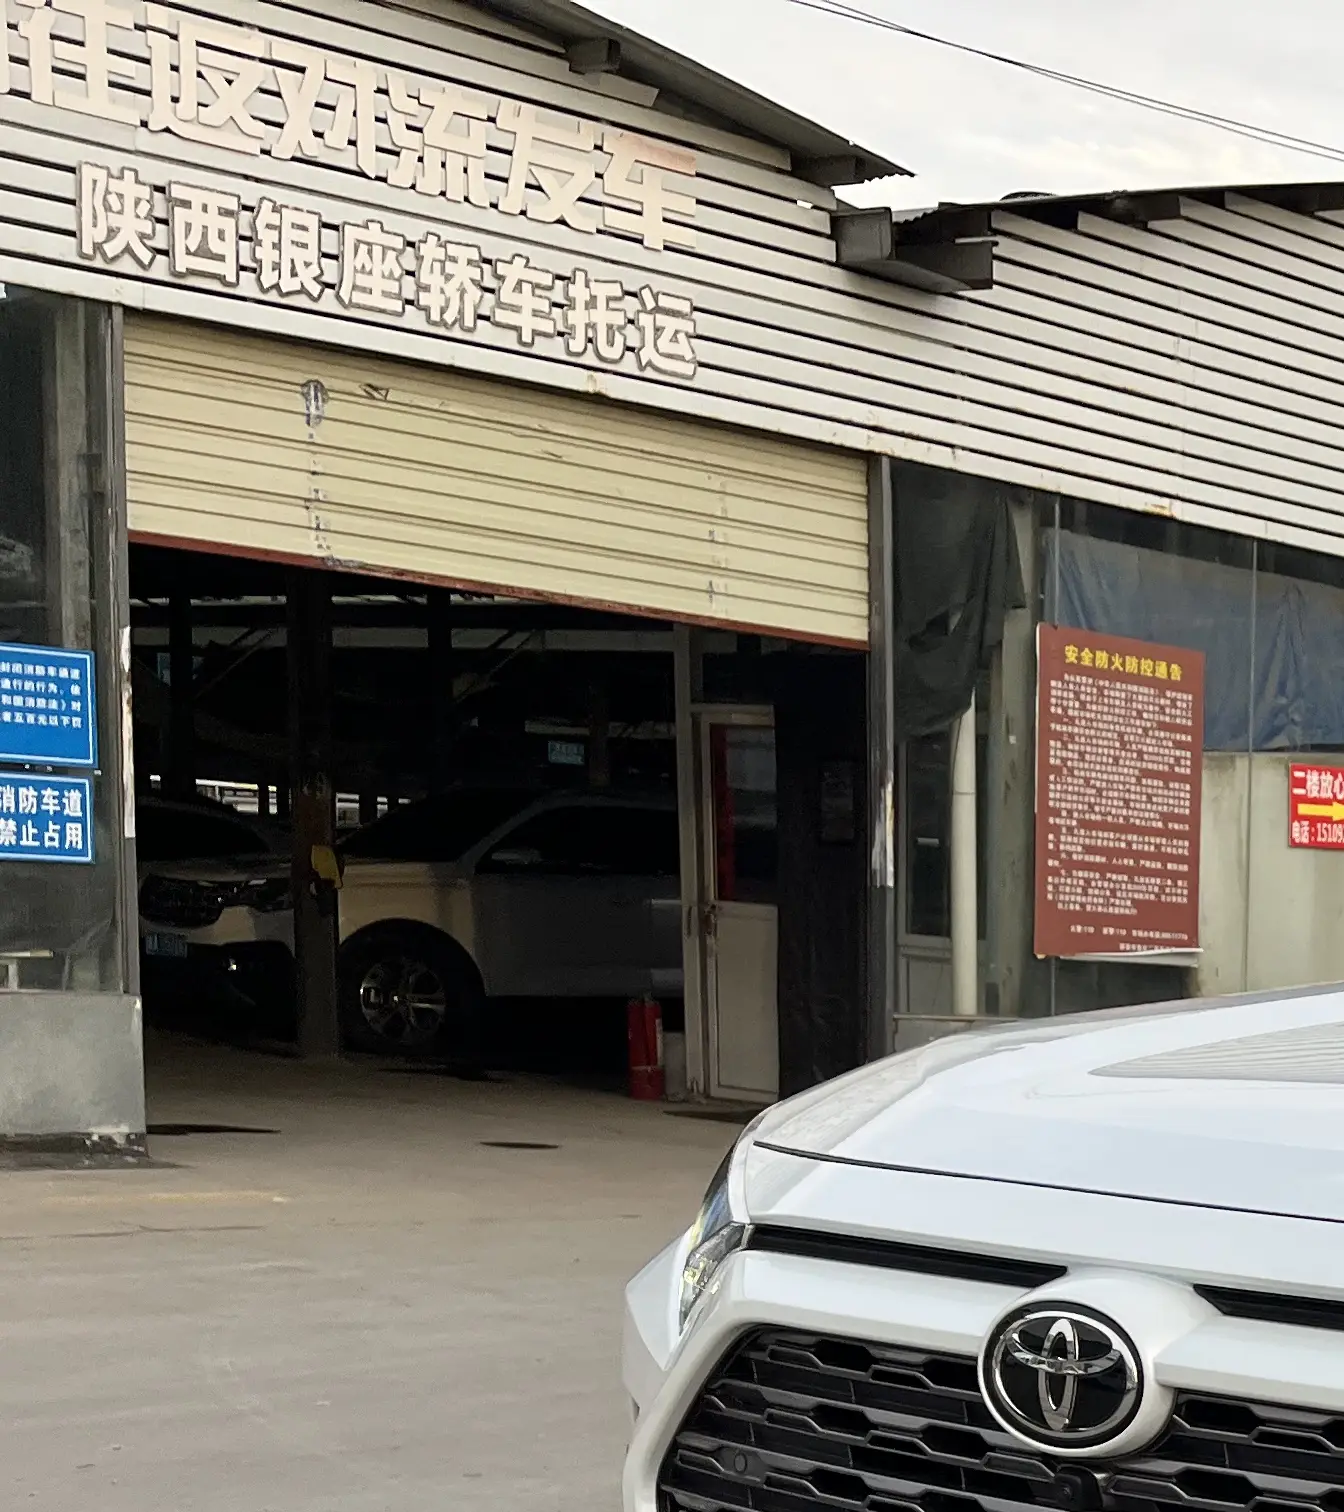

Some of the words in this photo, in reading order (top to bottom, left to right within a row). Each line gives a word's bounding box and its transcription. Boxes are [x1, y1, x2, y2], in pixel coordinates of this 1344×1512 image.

[0, 0, 697, 252] 往返对流发车
[75, 160, 699, 380] 陕西银座轿车托运
[1064, 644, 1182, 681] 安全防火防控通告
[0, 785, 83, 818] 消防车道
[0, 818, 83, 850] 禁止占用
